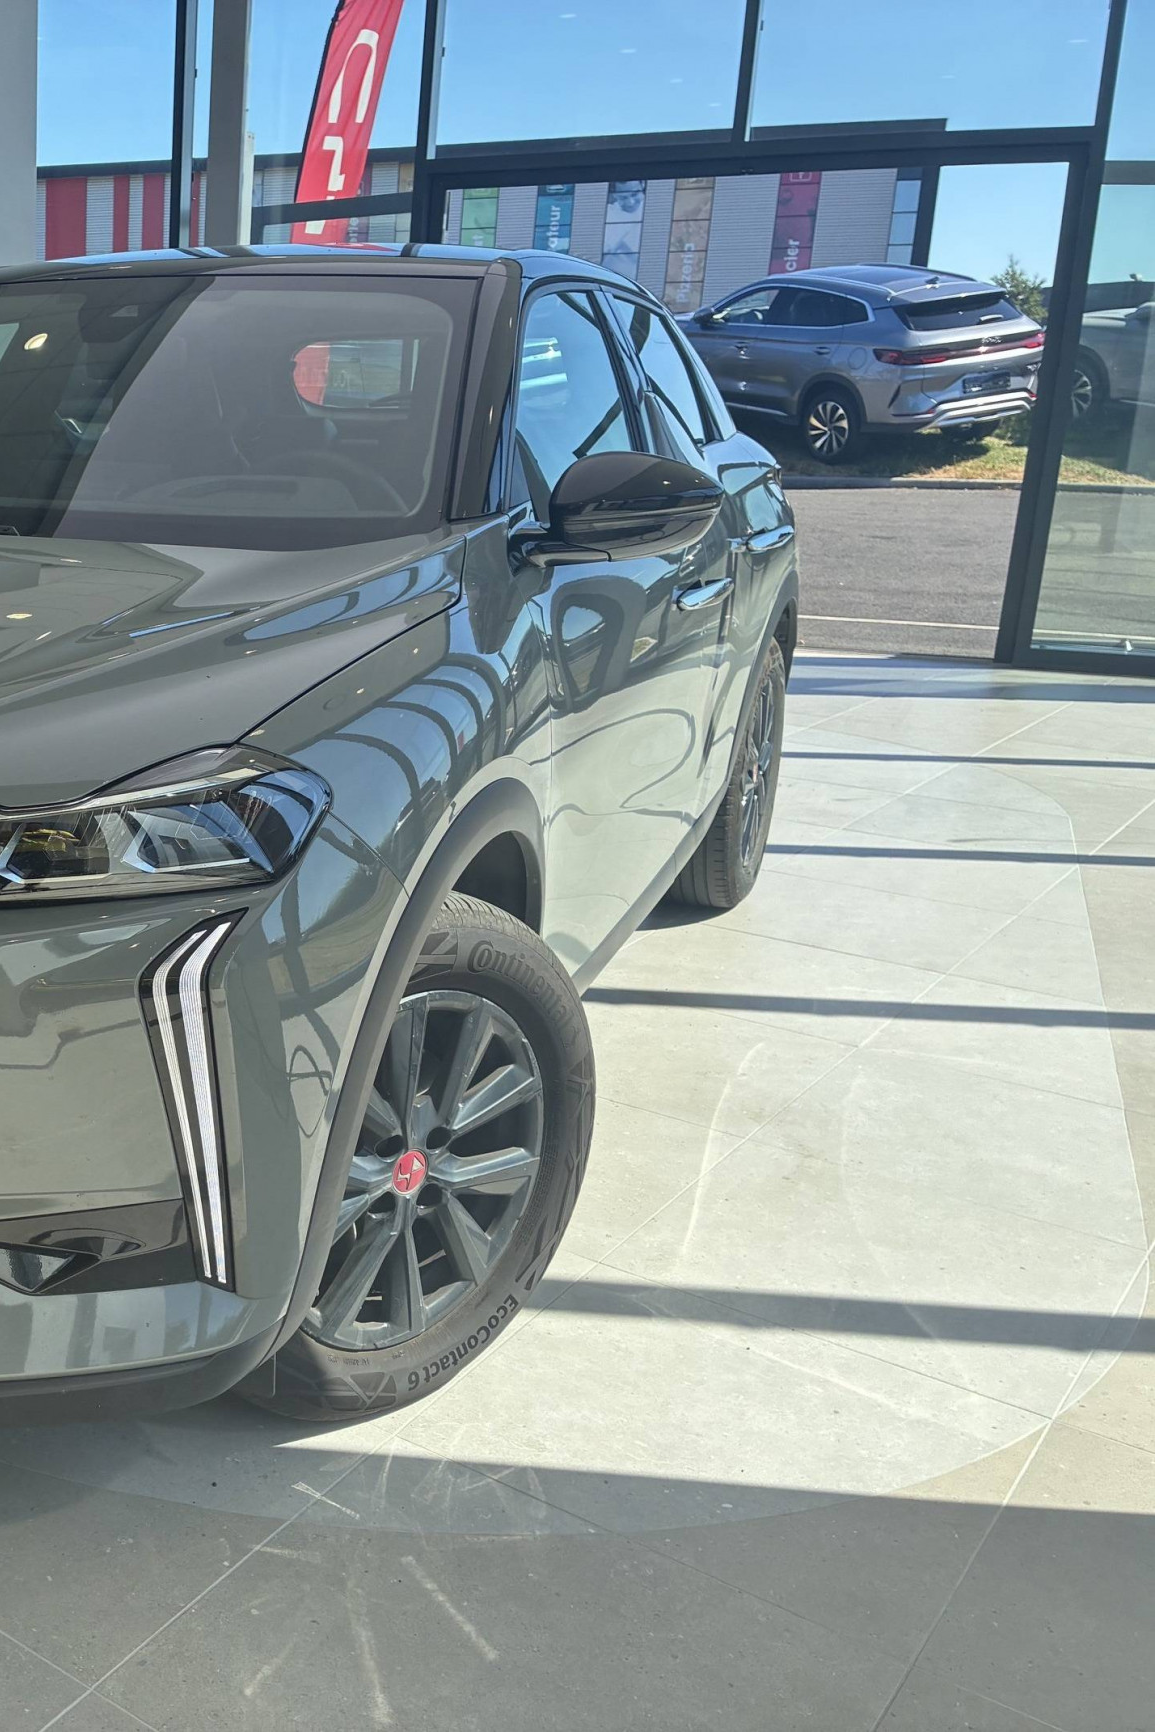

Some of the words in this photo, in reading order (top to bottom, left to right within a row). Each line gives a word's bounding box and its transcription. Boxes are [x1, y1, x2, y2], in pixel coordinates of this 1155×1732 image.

[467, 940, 575, 1031] Continental
[407, 1369, 421, 1392] 6
[423, 1293, 520, 1382] EcoContact
